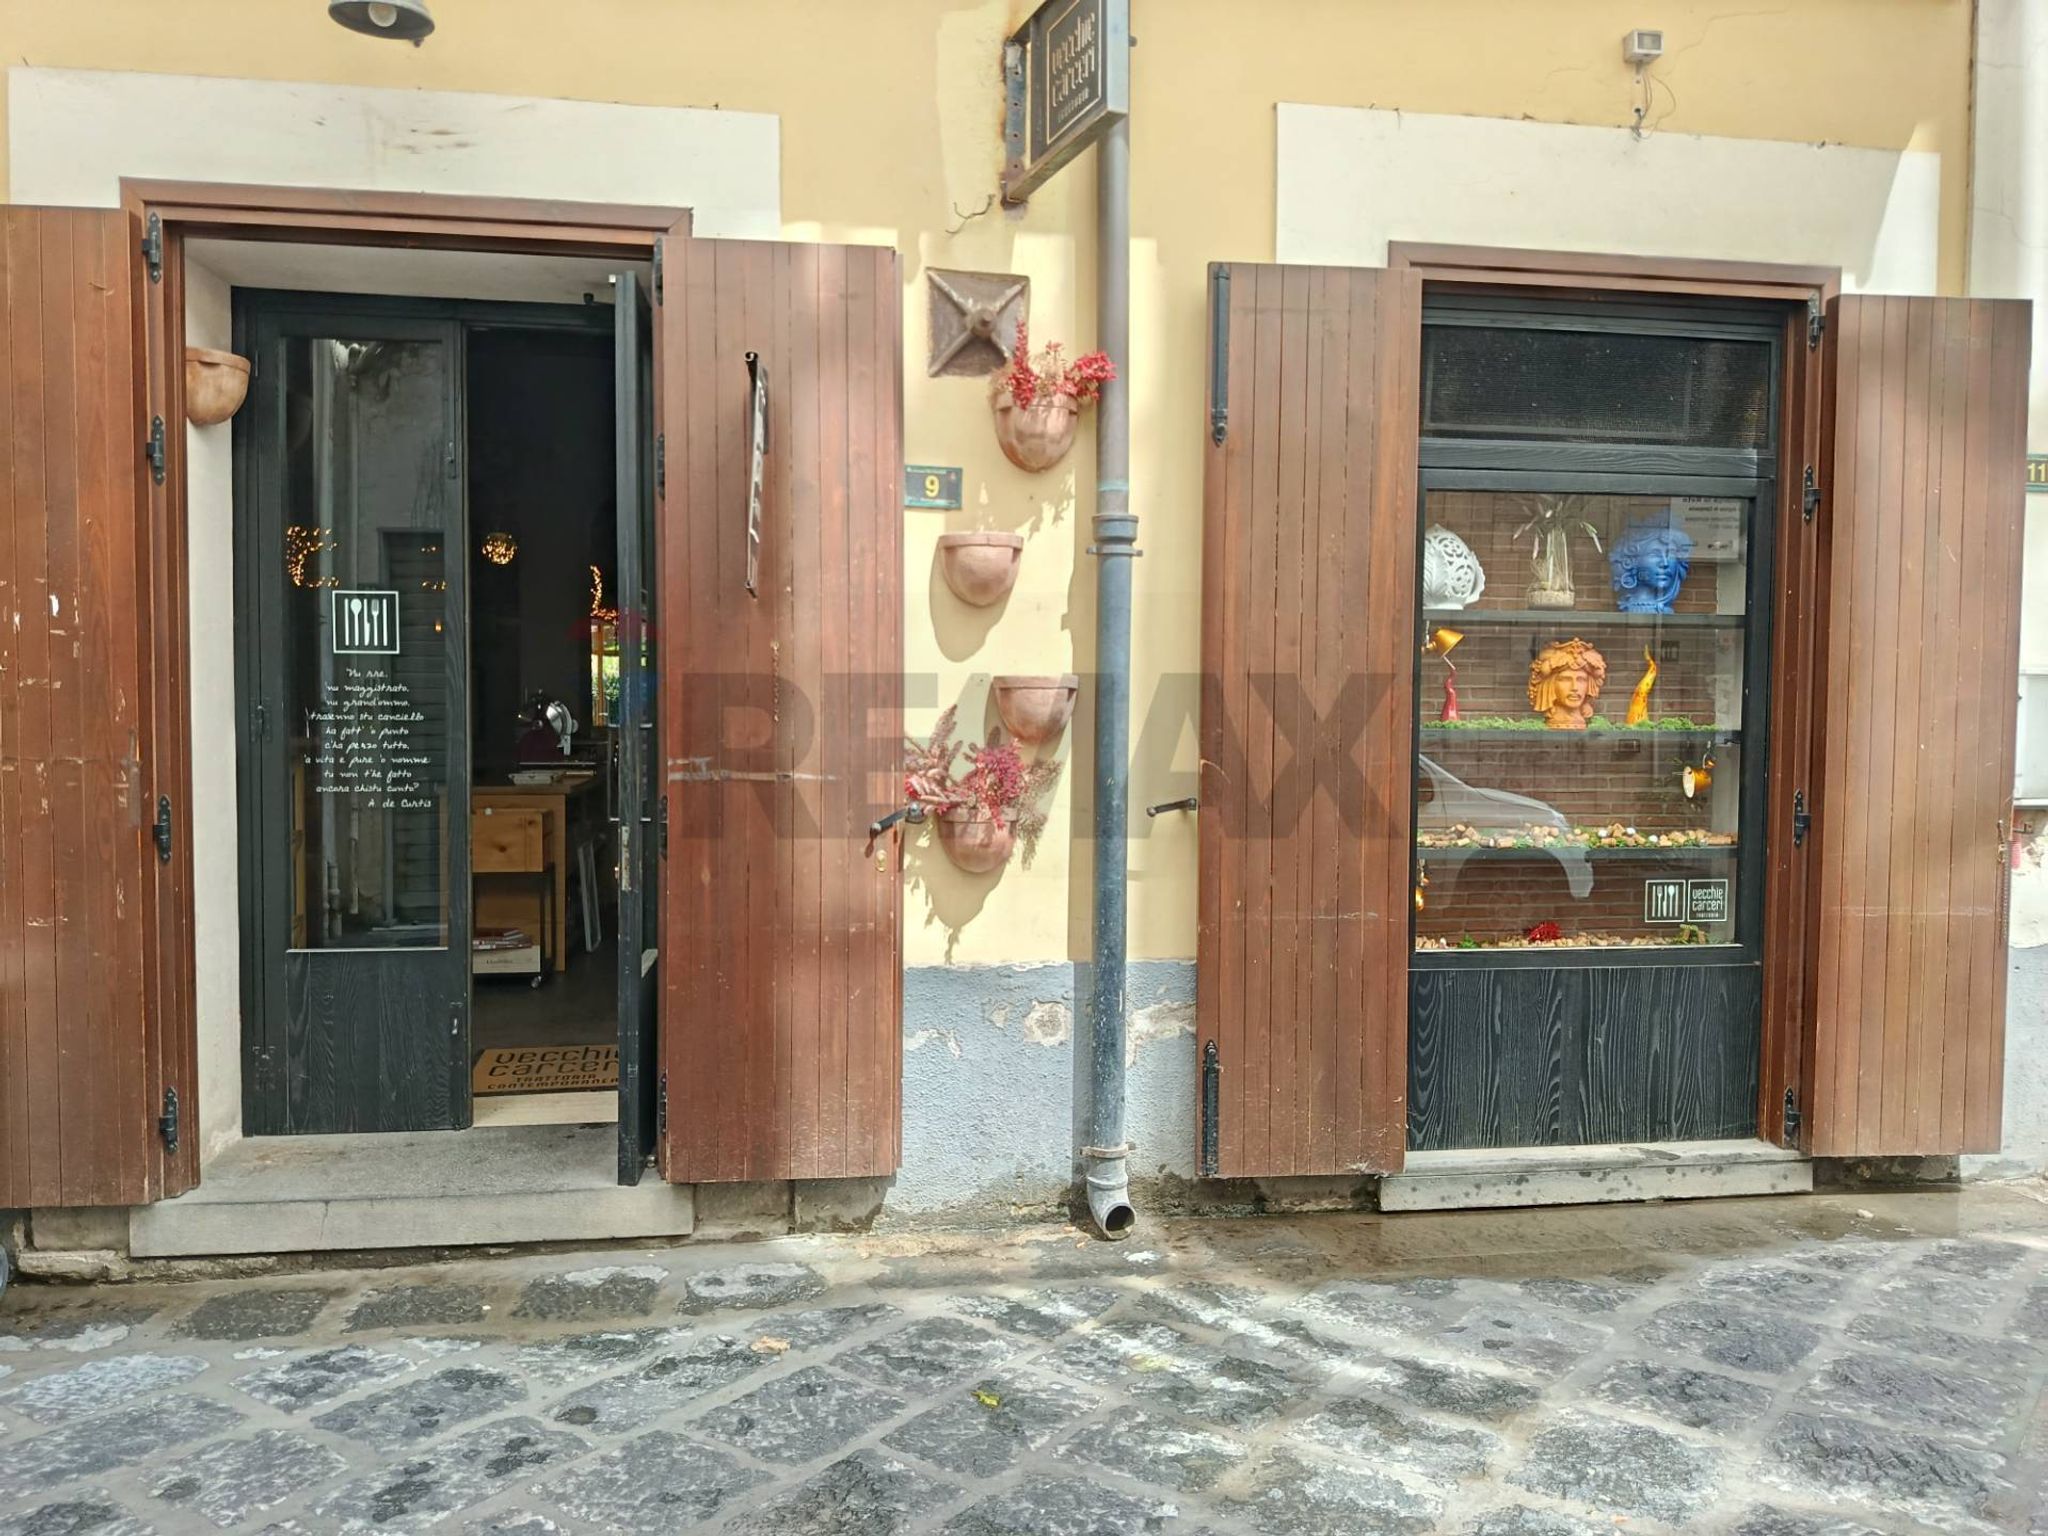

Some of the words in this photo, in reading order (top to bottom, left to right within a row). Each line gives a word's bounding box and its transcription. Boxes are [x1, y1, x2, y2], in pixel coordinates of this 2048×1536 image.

[2028, 463, 2046, 482] 11
[925, 475, 940, 498] 9
[378, 726, 409, 740] punto
[316, 754, 335, 763] vita
[348, 756, 373, 768] pure
[316, 784, 350, 793] ancora
[382, 798, 395, 808] de
[400, 798, 432, 808] Curtis
[1692, 885, 1724, 900] vecchie
[1692, 900, 1723, 911] carceri
